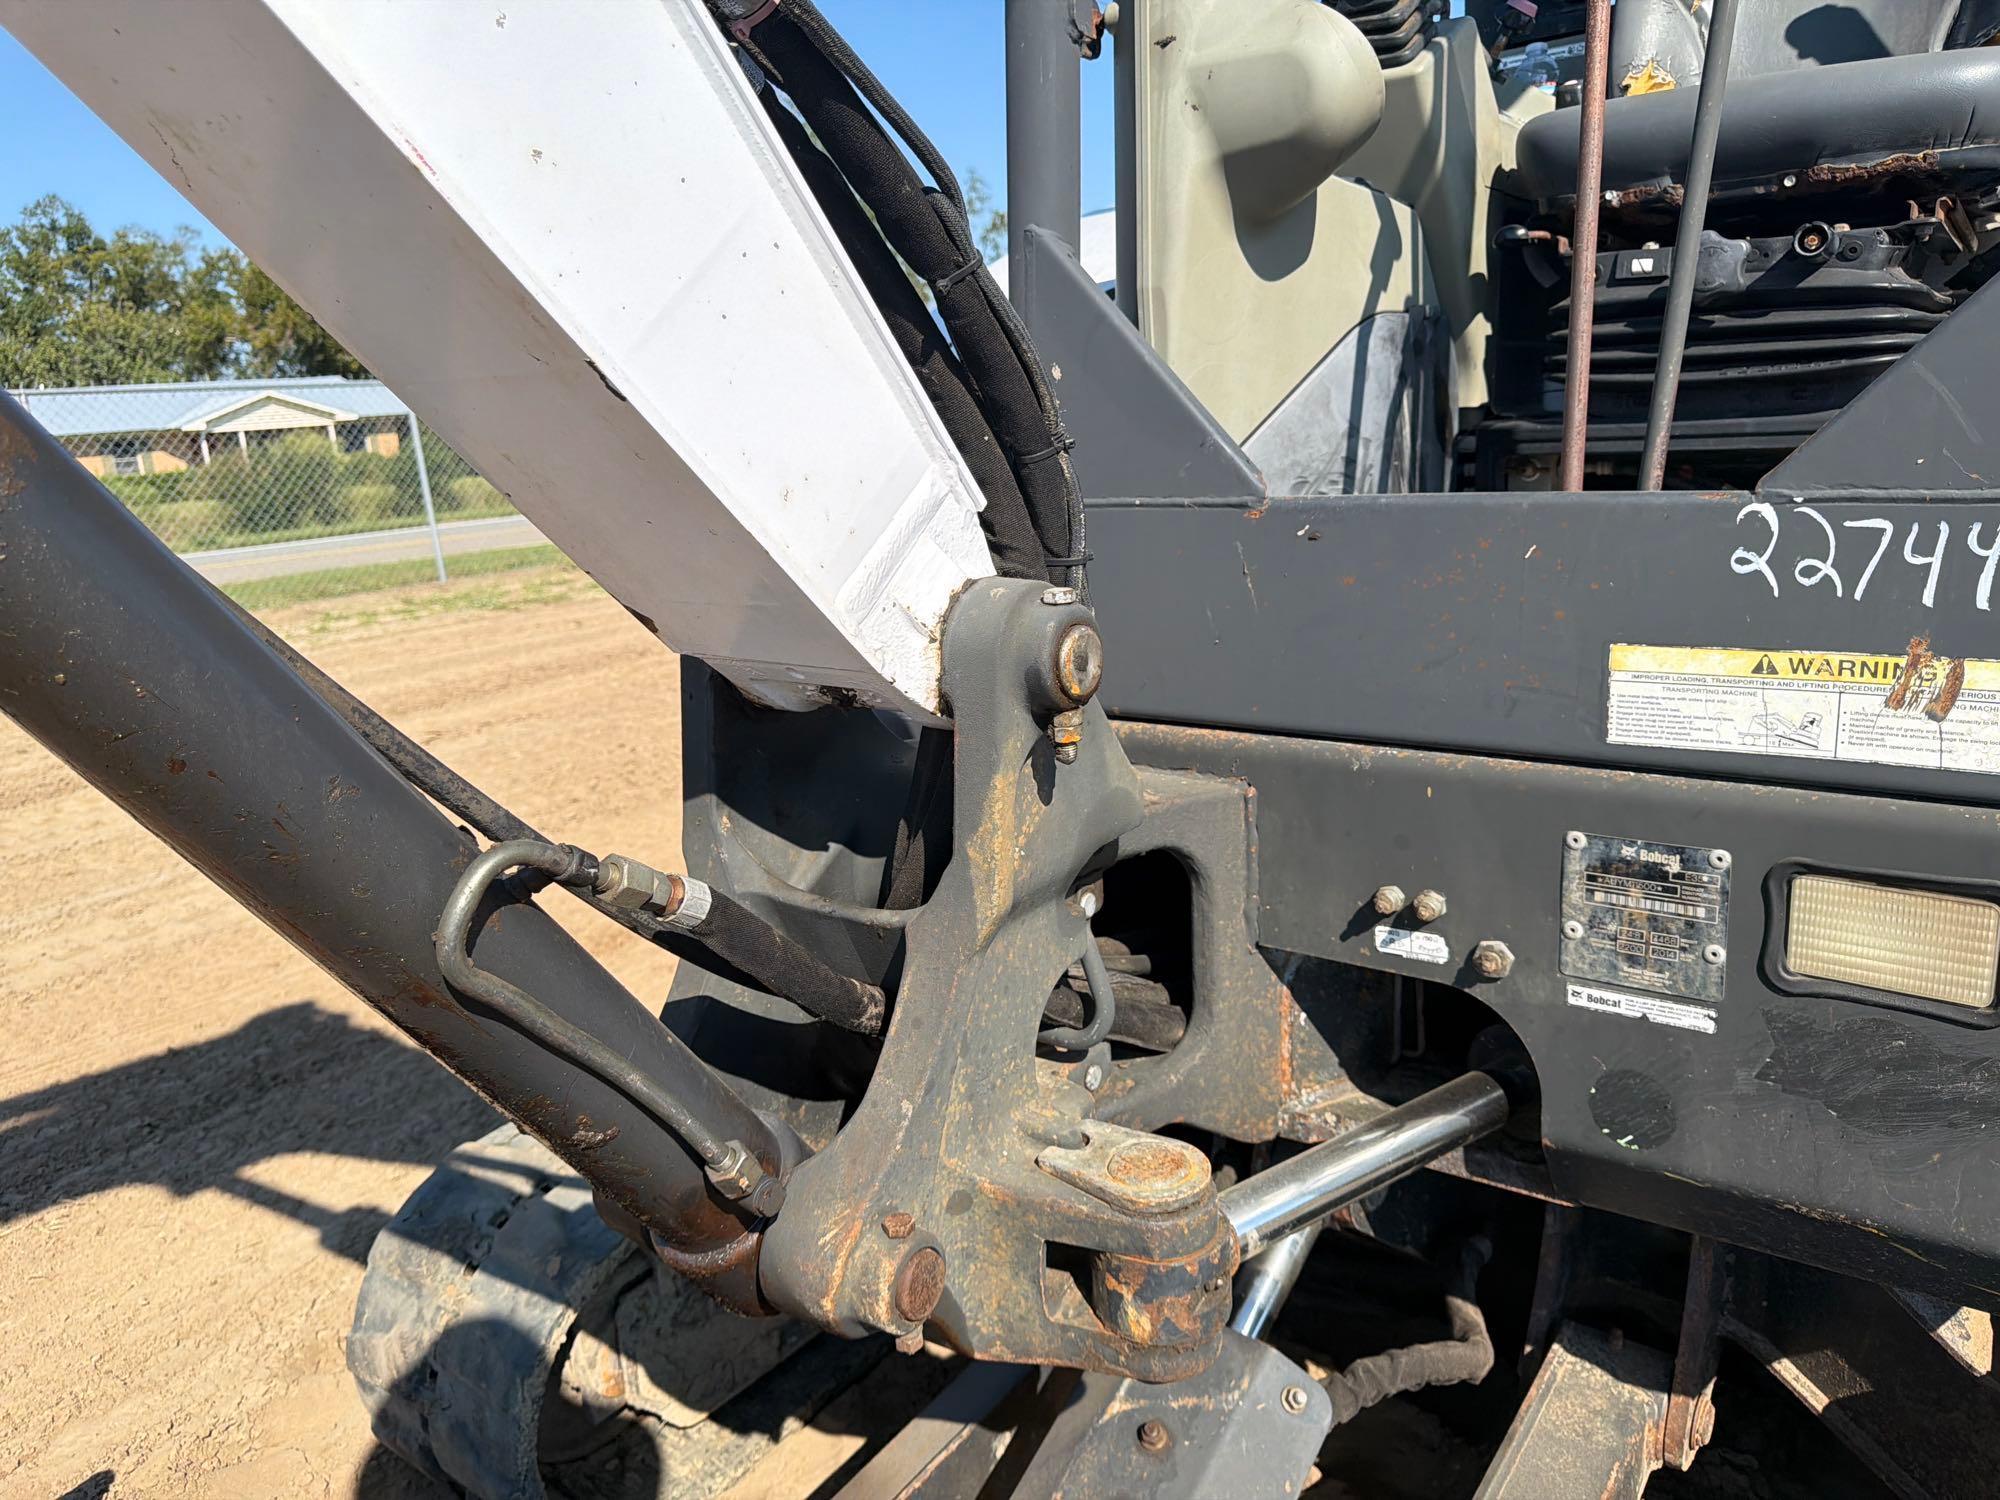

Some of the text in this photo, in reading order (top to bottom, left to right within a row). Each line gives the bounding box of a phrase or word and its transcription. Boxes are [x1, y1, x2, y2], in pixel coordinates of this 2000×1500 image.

[1673, 676, 1709, 684] LOADING,
[1712, 678, 1774, 686] TRANSPORTING
[1798, 682, 1830, 690] LIFTING
[1662, 686, 1758, 698] TRANSPORTING MACHINE
[1639, 849, 1681, 865] Bobcat
[1654, 949, 1675, 958] 2014
[1587, 993, 1621, 1009] Bobcat
